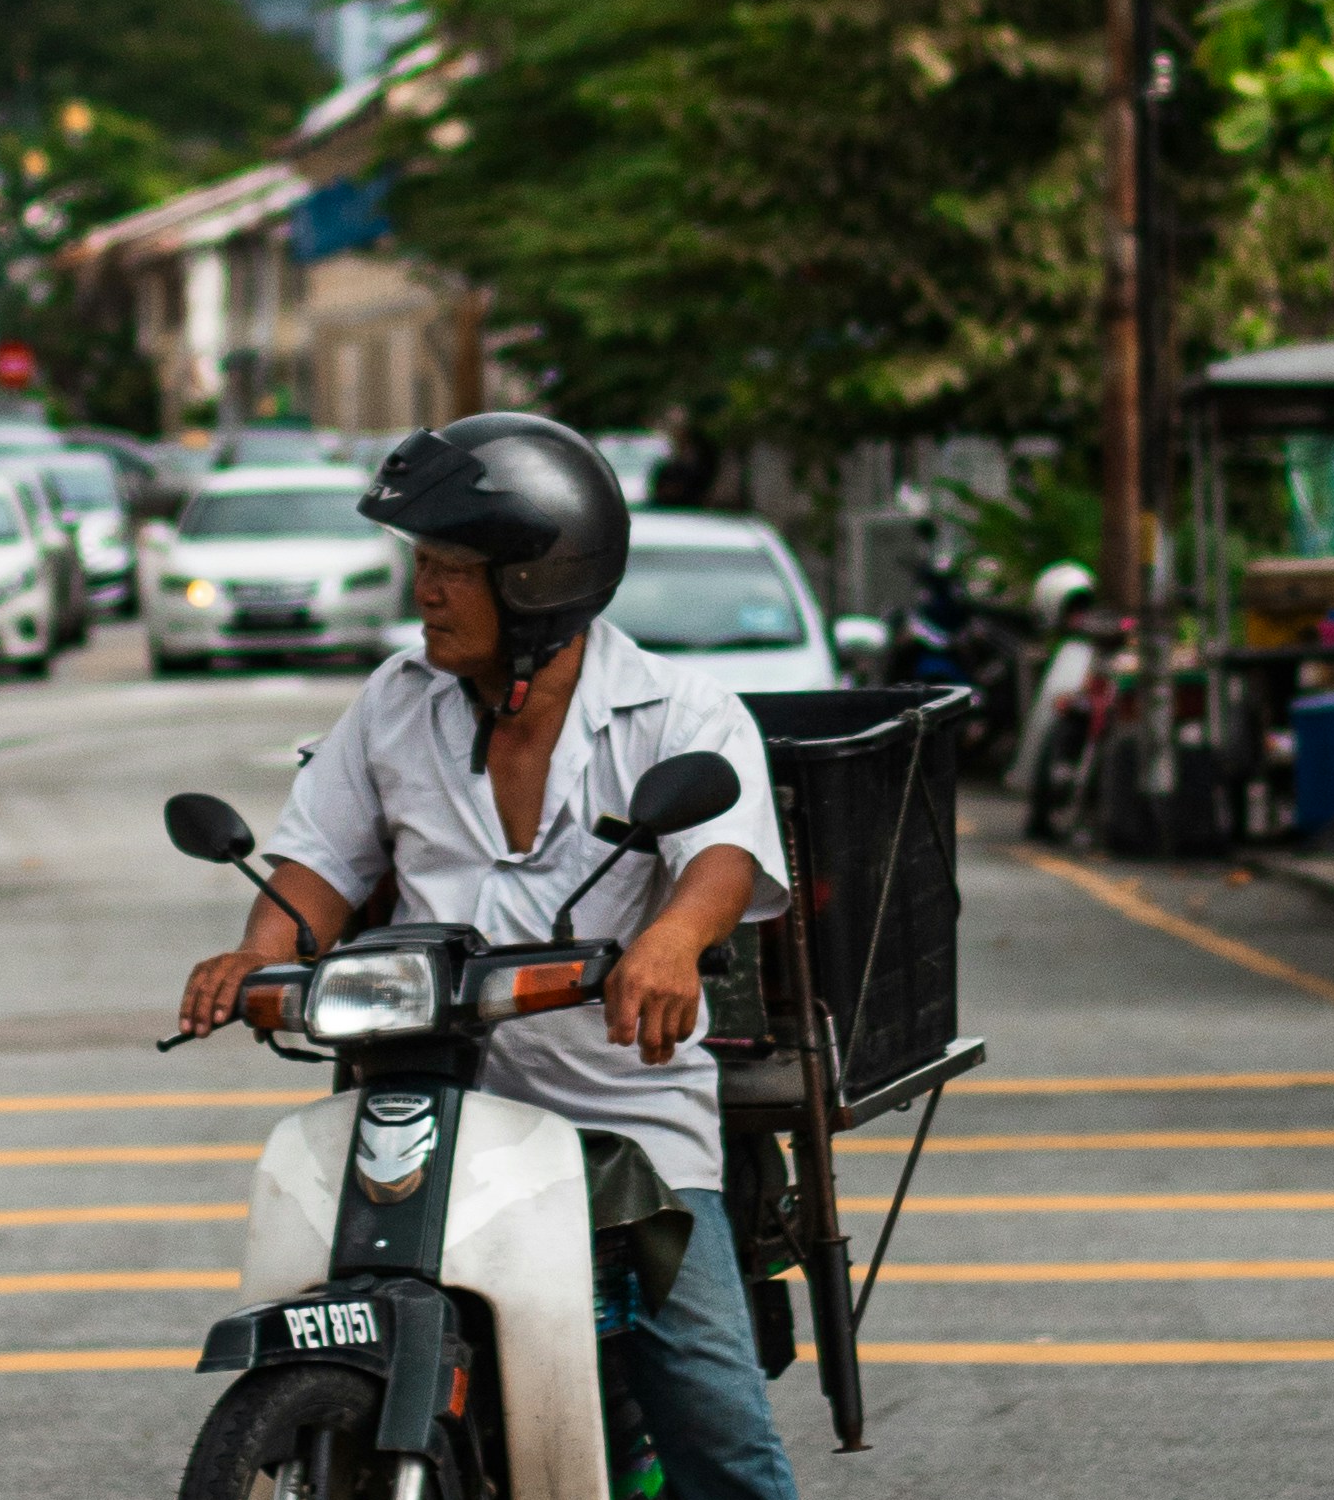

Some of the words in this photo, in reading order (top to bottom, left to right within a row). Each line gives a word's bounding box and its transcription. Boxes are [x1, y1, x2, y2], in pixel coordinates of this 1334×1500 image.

[371, 1096, 424, 1105] HONDA
[284, 1306, 329, 1349] PEY
[328, 1303, 378, 1345] 8151
